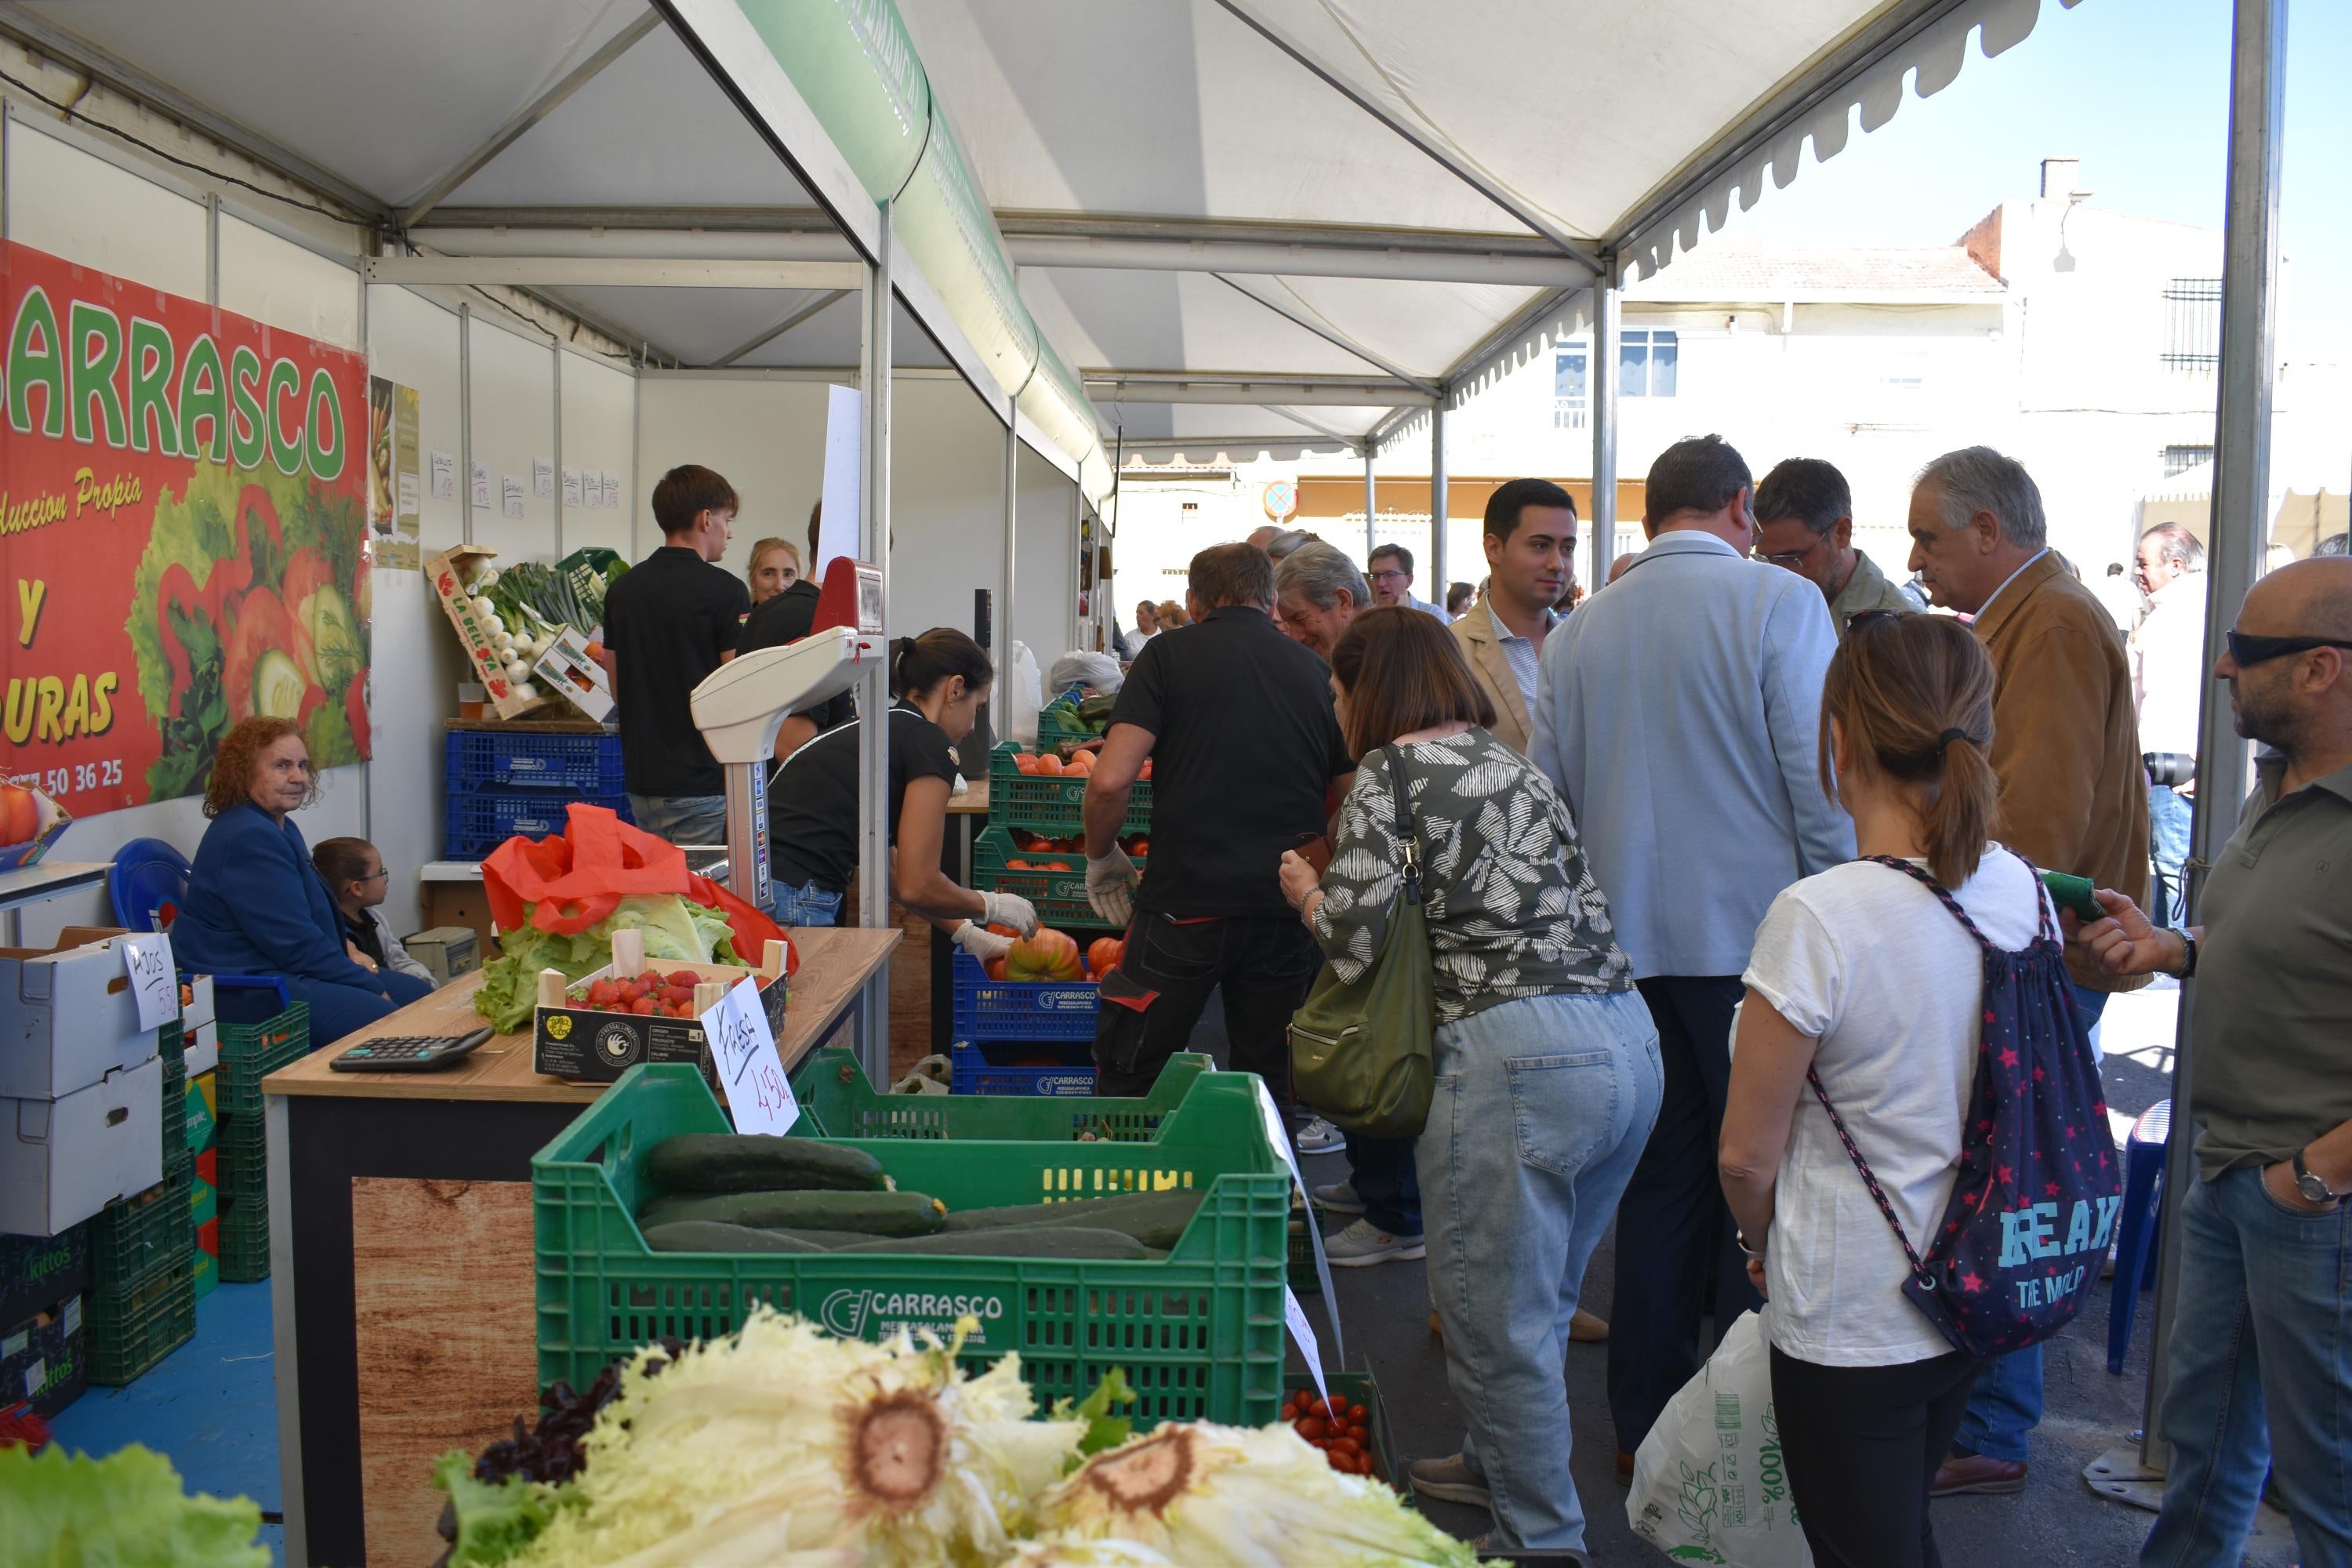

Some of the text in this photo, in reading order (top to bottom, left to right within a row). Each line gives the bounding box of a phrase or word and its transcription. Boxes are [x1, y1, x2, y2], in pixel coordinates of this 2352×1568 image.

[0, 285, 346, 481] ARRASCO
[75, 467, 142, 519] Propia
[18, 579, 45, 645] Y
[452, 597, 467, 614] LA
[0, 671, 118, 743] URAS
[47, 768, 69, 797] 50
[75, 763, 96, 792] 36
[102, 759, 122, 786] 25
[1055, 991, 1095, 1000] CARRASCO
[1054, 1076, 1094, 1085] CARRASCO
[871, 1293, 1003, 1319] CARRASCO
